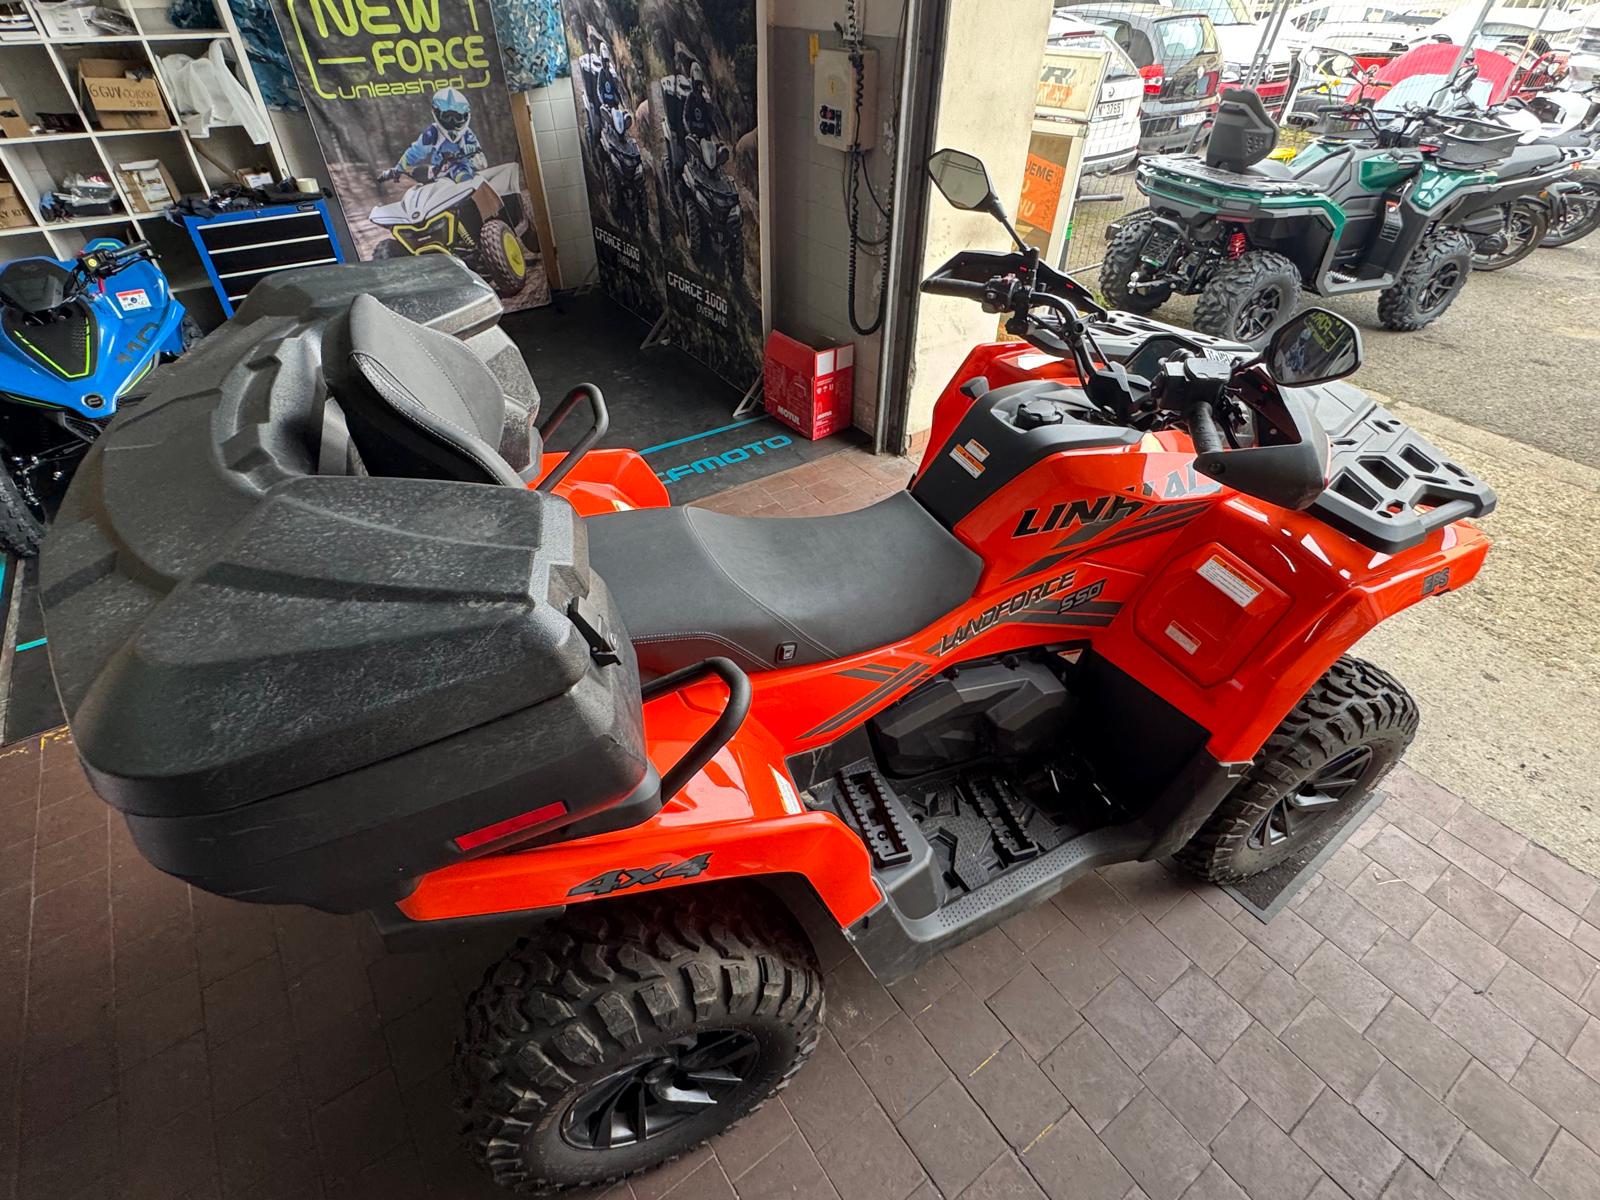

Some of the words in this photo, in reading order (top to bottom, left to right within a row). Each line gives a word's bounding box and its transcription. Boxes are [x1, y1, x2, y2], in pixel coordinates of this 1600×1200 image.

[308, 0, 442, 39] NEW
[371, 35, 490, 76] FORCE
[337, 74, 465, 100] unleashed
[594, 226, 621, 252] CFORCE
[622, 241, 640, 262] 1000
[667, 271, 703, 301] CFORCE
[704, 289, 728, 315] 1000
[696, 303, 728, 328] OVERLAND
[777, 405, 801, 425] MOTUL
[938, 568, 1078, 657] LANDFORCE
